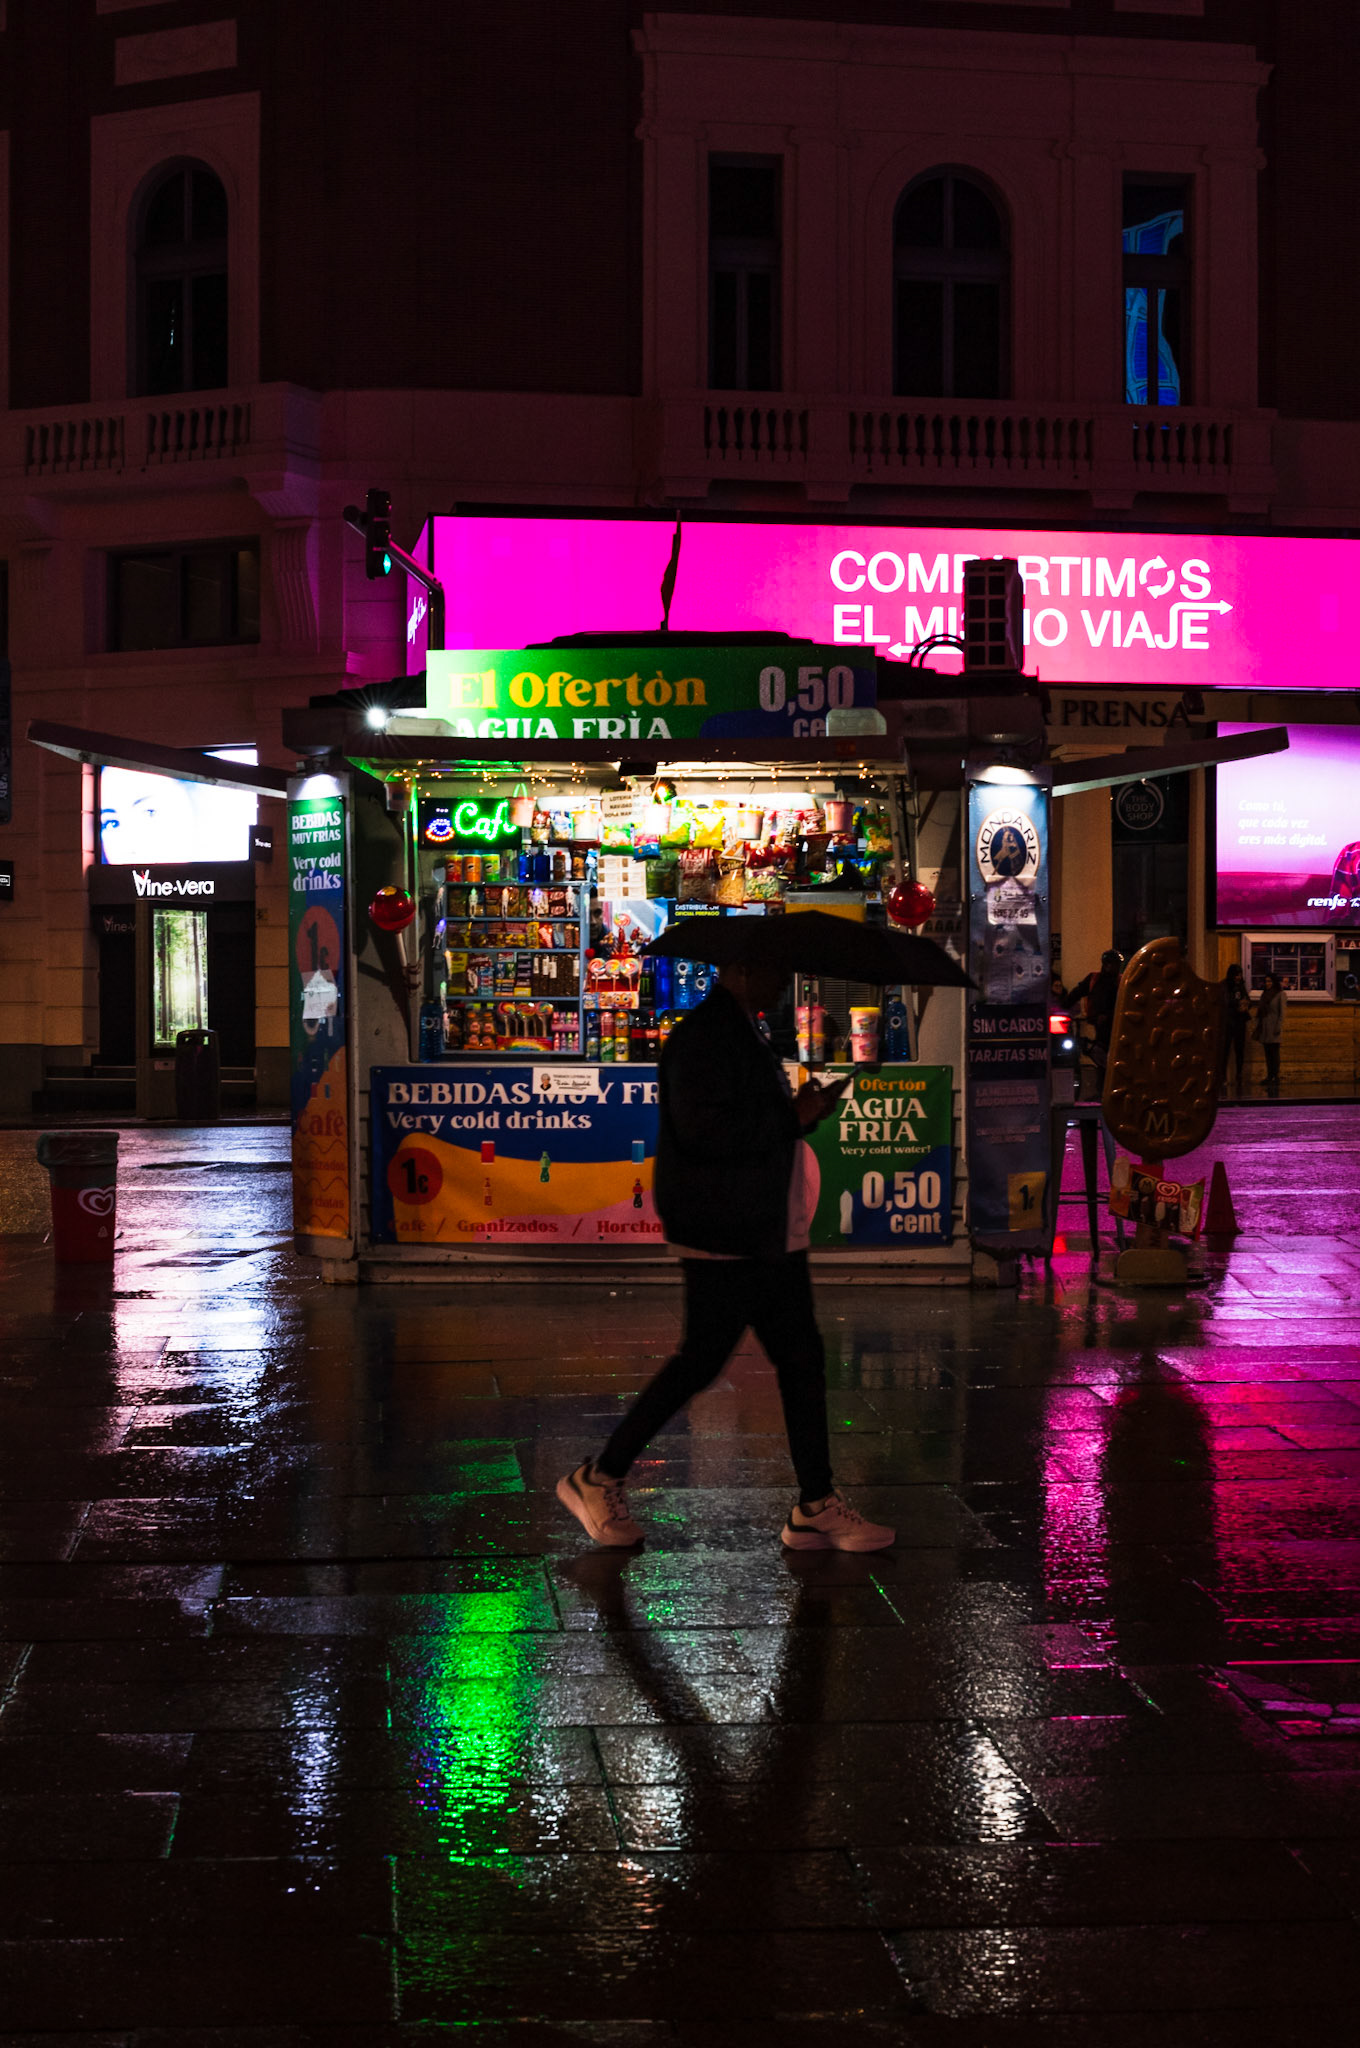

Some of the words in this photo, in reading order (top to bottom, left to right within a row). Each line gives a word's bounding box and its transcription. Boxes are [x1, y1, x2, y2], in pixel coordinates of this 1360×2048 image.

[830, 550, 1211, 600] COMRTIMOS
[833, 604, 890, 642] EL
[905, 605, 1067, 647] MIO
[1080, 606, 1209, 650] VIAJE
[448, 669, 498, 709] El
[758, 665, 855, 716] 0,50
[1061, 699, 1191, 727] PRENSA
[1126, 803, 1154, 812] BODY
[1239, 799, 1269, 811] Como
[292, 811, 342, 830] BEBIDAS
[1128, 812, 1153, 821] SHOP
[1239, 818, 1259, 830] que
[1262, 816, 1288, 828] cada
[1291, 819, 1309, 828] vez
[292, 832, 312, 845] MUY
[980, 811, 1037, 865] MONDARIZ
[1239, 835, 1261, 845] eres
[1263, 833, 1287, 845] más
[293, 857, 317, 877] Very
[319, 852, 341, 868] cold
[293, 870, 341, 891] drinks
[1307, 894, 1347, 910] renfe
[972, 1018, 996, 1033] SIM
[998, 1018, 1044, 1033] CARDS
[968, 1049, 1026, 1063] TARJETAS
[1028, 1048, 1048, 1062] SIM
[387, 1082, 530, 1105] BEBIDAS
[840, 1097, 928, 1119] AGUA
[387, 1112, 444, 1134] Very
[450, 1111, 500, 1129] cold
[506, 1110, 592, 1130] drinks
[1145, 1110, 1169, 1136] M
[841, 1146, 866, 1157] Very
[869, 1145, 891, 1154] cold
[894, 1144, 931, 1154] water!
[862, 1170, 941, 1212] 0,50
[457, 1218, 559, 1233] Granizados
[890, 1212, 941, 1234] cent
